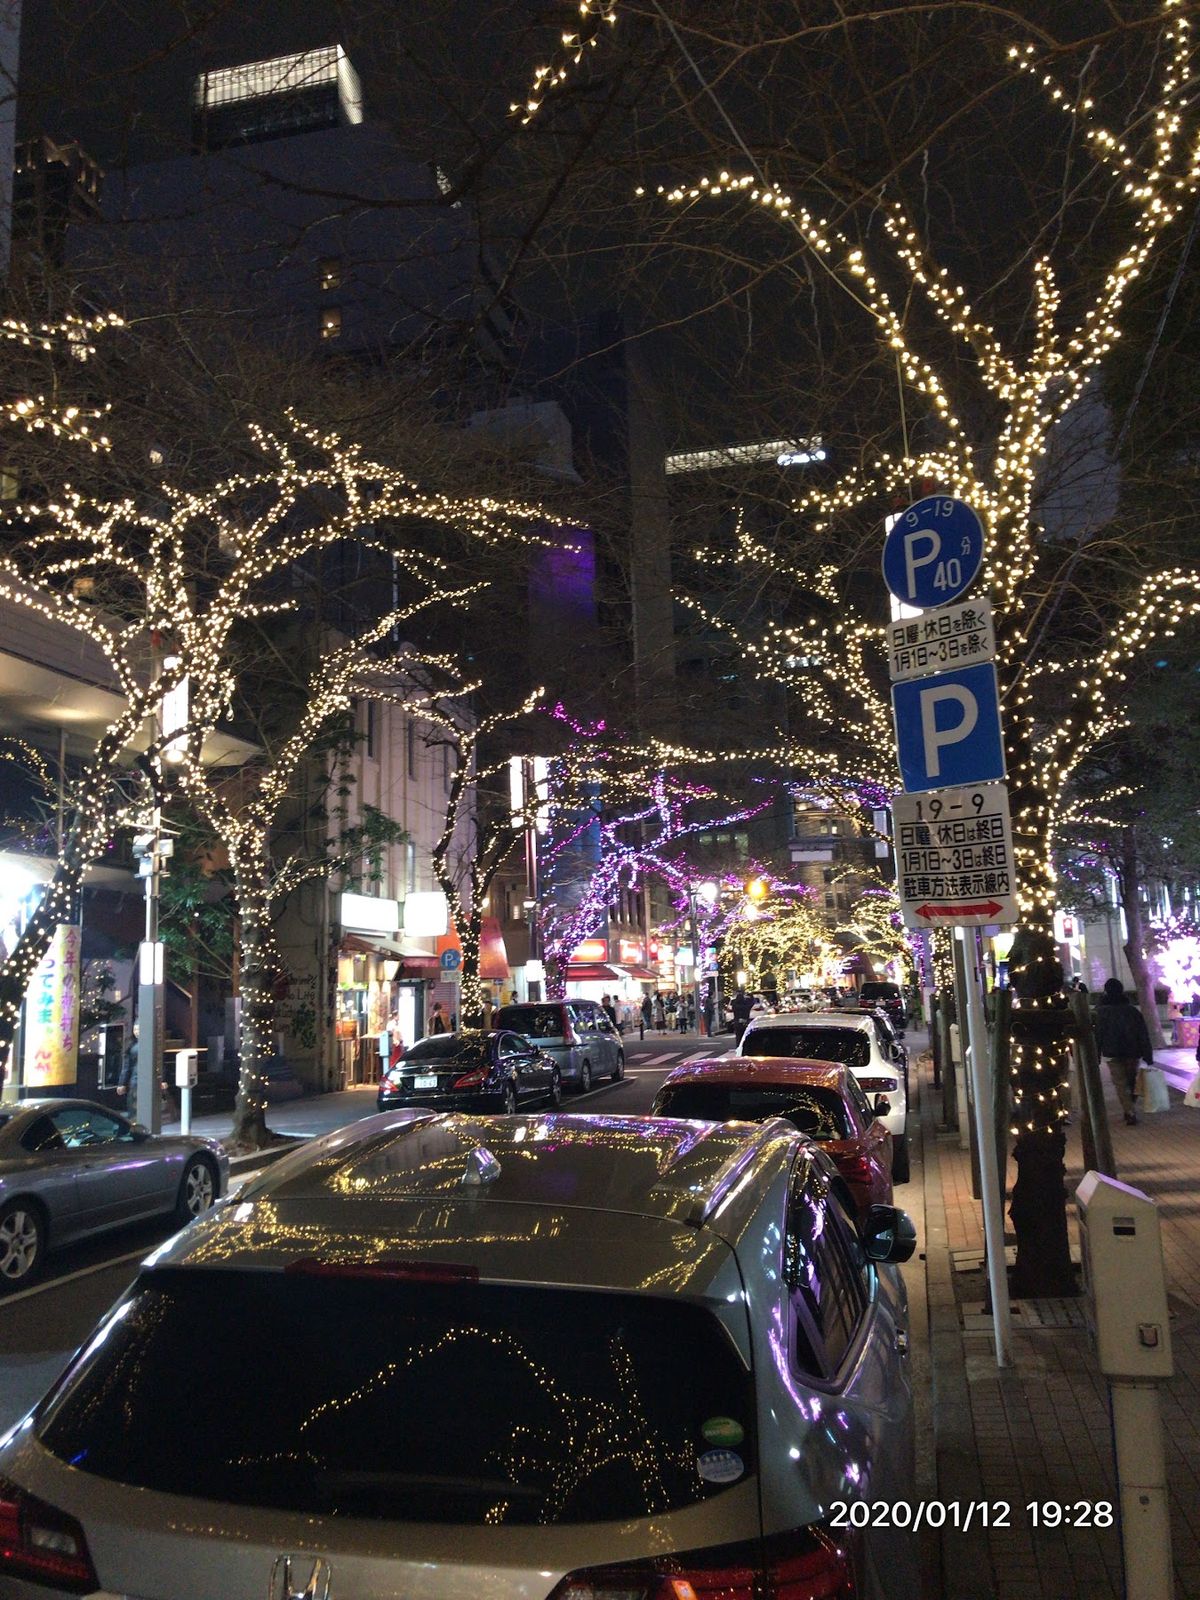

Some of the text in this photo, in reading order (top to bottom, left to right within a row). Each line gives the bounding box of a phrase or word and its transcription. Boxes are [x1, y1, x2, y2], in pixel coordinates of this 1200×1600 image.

[905, 500, 955, 527] 9-19
[960, 536, 971, 556] 分
[904, 529, 941, 599] P
[933, 558, 961, 591] 40
[920, 683, 979, 778] P
[904, 871, 1010, 899] 駐車方法表示線内
